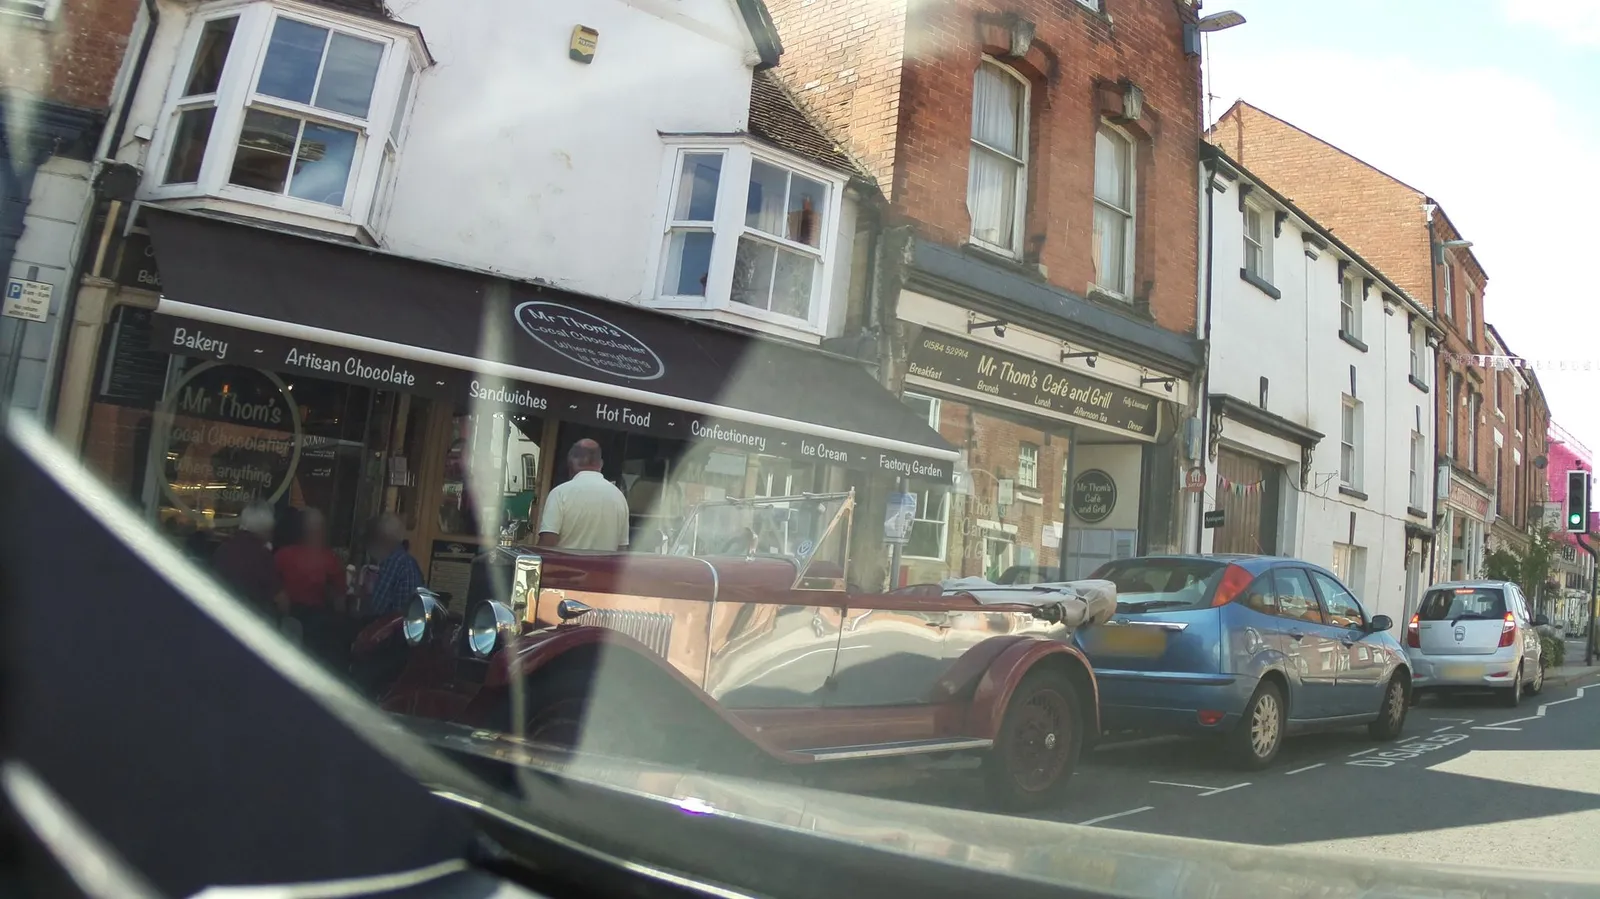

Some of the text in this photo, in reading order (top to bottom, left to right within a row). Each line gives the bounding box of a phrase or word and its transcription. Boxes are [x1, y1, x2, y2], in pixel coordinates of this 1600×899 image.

[526, 321, 646, 355] Local Chocolatier
[527, 308, 621, 338] Mr Thom's
[598, 350, 652, 369] anything
[923, 340, 969, 359] 01584 529914
[909, 363, 1143, 432] Breakfast Brunch Lunch Afternoon Tea Dinner
[977, 355, 1113, 409] Mr Thom's Café and Grill
[172, 327, 943, 478] Bakery Artisan Chocolate Sandwiches Hot Food Confectionery Ice Cream Factory Garden
[179, 385, 282, 424] Mr Thom's
[216, 463, 272, 488] anything
[1345, 733, 1470, 767] DISABLED
